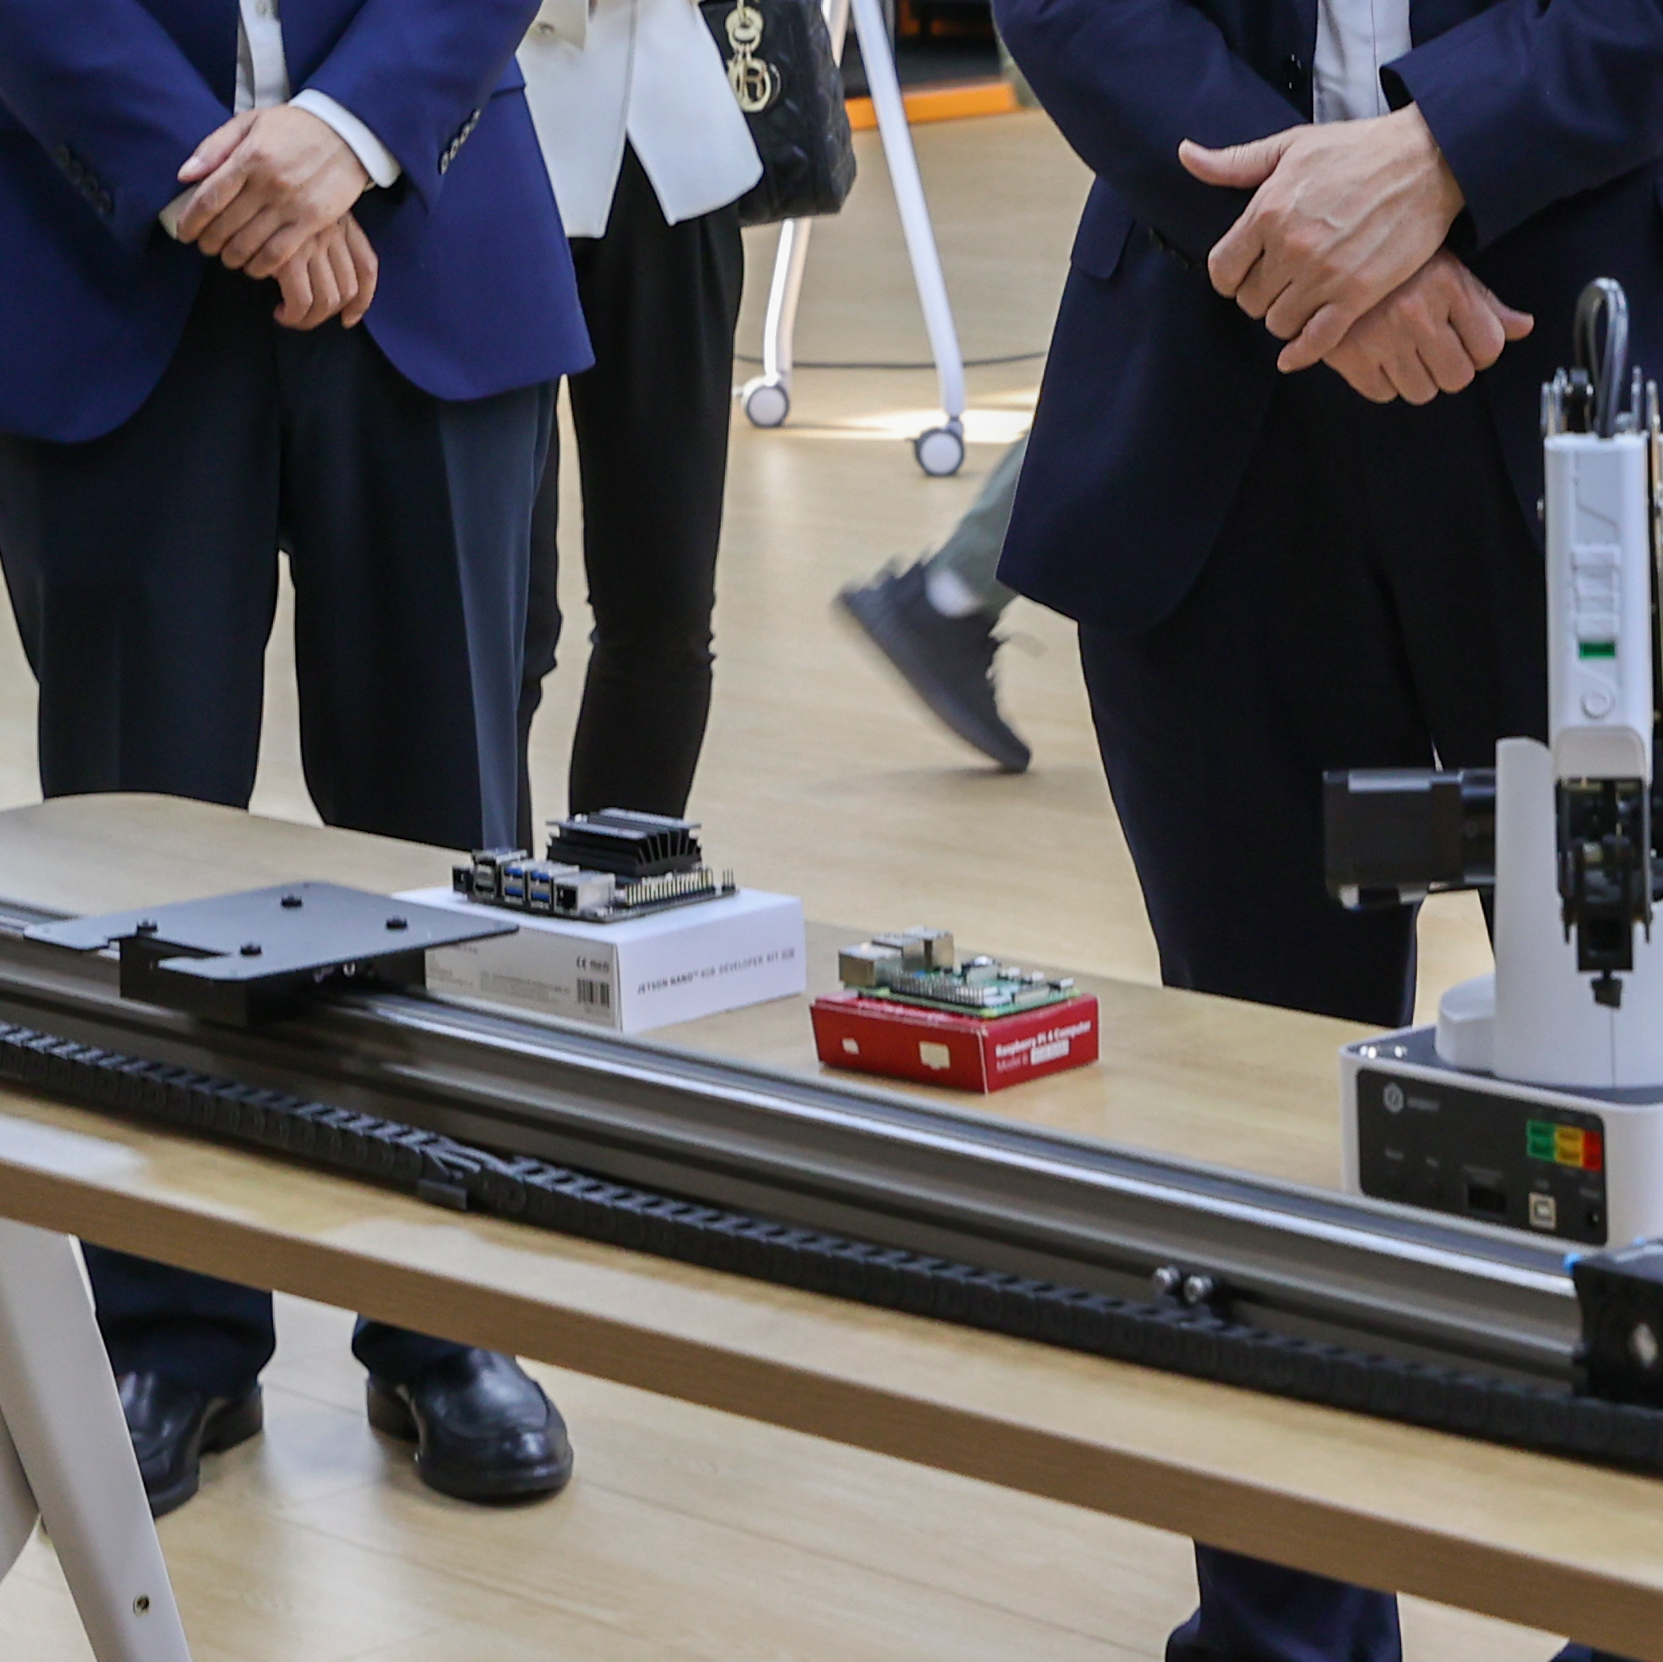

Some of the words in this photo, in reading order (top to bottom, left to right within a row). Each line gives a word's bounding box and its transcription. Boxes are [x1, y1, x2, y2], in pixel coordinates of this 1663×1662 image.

[637, 979, 668, 995] JETSON
[719, 955, 763, 975] DEVELOPER
[995, 1037, 1036, 1058] Raspberry
[1054, 1020, 1091, 1039] Computer
